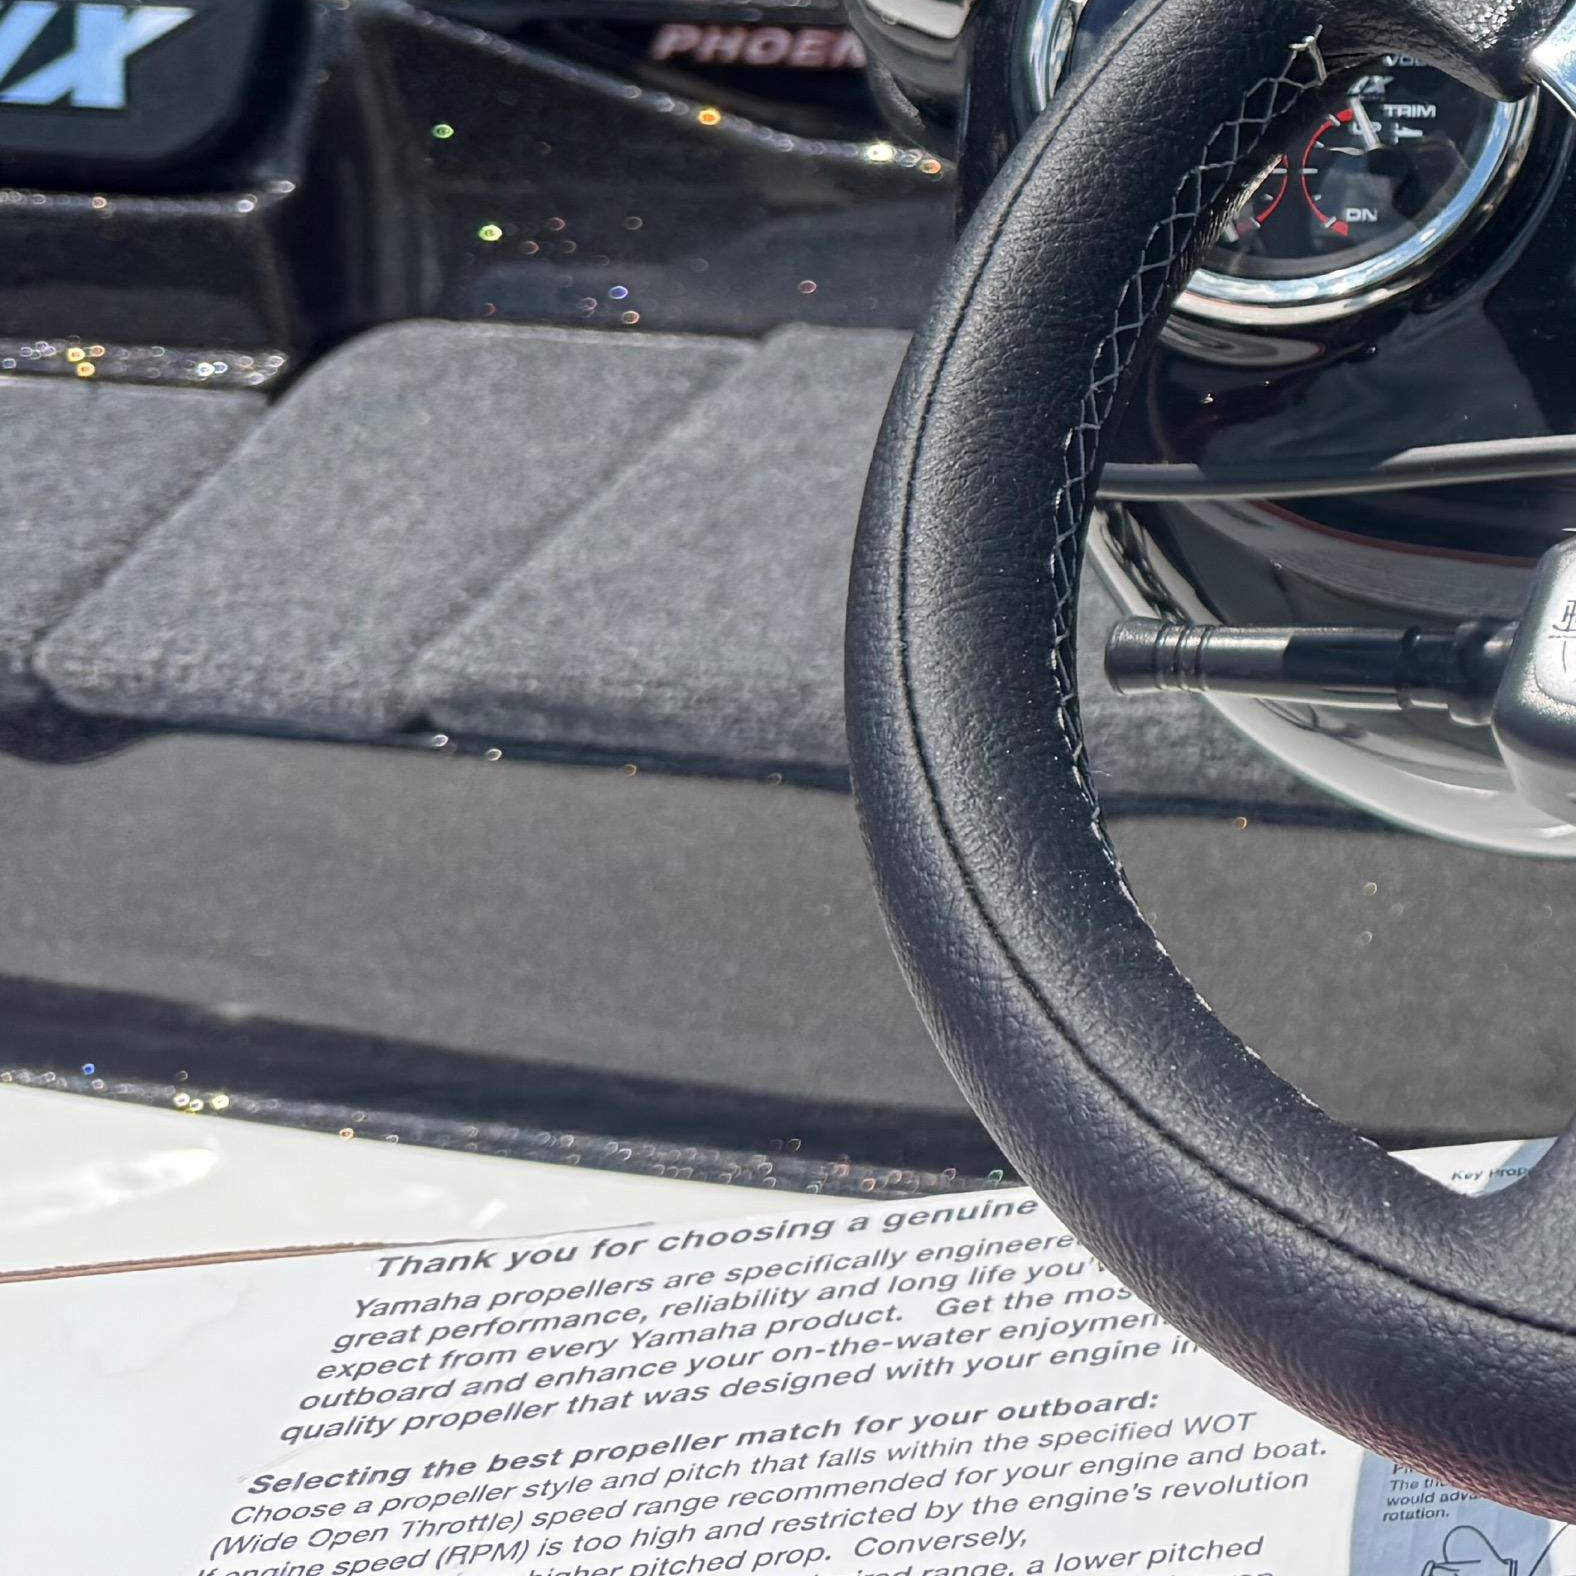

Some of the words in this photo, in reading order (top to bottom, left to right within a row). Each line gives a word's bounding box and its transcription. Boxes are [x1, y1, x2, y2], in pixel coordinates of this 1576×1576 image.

[1383, 104, 1436, 119] TRIM
[1345, 208, 1378, 222] DN
[377, 1249, 498, 1277] Thank
[503, 1242, 579, 1272] you
[590, 1238, 648, 1260] for
[658, 1220, 836, 1252] choosing
[847, 1217, 870, 1232] a
[882, 1198, 1038, 1233] genuine
[331, 1324, 422, 1353] great
[425, 1308, 647, 1346] performance,
[659, 1287, 810, 1318] reliability
[816, 1277, 880, 1301] and
[888, 1274, 958, 1294] long
[968, 1265, 1016, 1286] life
[356, 1292, 481, 1318] Yamaha
[486, 1278, 655, 1312] propellers
[663, 1271, 715, 1289] are
[724, 1248, 907, 1285] specifically
[299, 1378, 456, 1410] outboard
[461, 1372, 528, 1396] and
[535, 1361, 677, 1388] enhance
[683, 1350, 764, 1377] your
[772, 1327, 992, 1363] on-the-water
[999, 1313, 1166, 1341] enjoymen
[317, 1353, 432, 1381] expect
[439, 1349, 517, 1369] from
[526, 1338, 619, 1361] every
[632, 1321, 757, 1350] Yamaha
[764, 1305, 902, 1339] product.
[936, 1295, 994, 1316] Get
[1004, 1291, 1054, 1310] the
[280, 1415, 398, 1445] quality
[400, 1401, 559, 1436] propeller
[566, 1390, 634, 1414] that
[644, 1386, 710, 1406] was
[720, 1363, 876, 1398] designed
[887, 1356, 954, 1380] with
[962, 1352, 1042, 1378] your
[1050, 1340, 1161, 1366] engine
[231, 1503, 346, 1525] Choose
[353, 1500, 373, 1514] a
[378, 1484, 518, 1517] propeller
[522, 1475, 593, 1501] style
[600, 1466, 660, 1490] and
[663, 1459, 740, 1488] pitch
[751, 1453, 808, 1474] that
[817, 1447, 876, 1469] falls
[888, 1437, 973, 1461] within
[984, 1433, 1029, 1452] the
[1038, 1419, 1173, 1451] specified
[1185, 1413, 1257, 1436] WOT
[248, 1466, 412, 1494] Selecting
[422, 1459, 477, 1479] the
[486, 1449, 564, 1473] best
[569, 1434, 729, 1469] propeller
[735, 1419, 841, 1446] match
[854, 1415, 903, 1435] for
[908, 1409, 989, 1434] your
[997, 1390, 1159, 1421] outboard:
[210, 1532, 298, 1561] (Wide
[308, 1527, 389, 1551] Open
[402, 1510, 523, 1539] Throttle)
[531, 1499, 628, 1530] speed
[632, 1496, 719, 1517] range
[727, 1468, 947, 1508] recommended
[955, 1466, 998, 1486] for
[1002, 1462, 1072, 1487] your
[1080, 1452, 1178, 1476] engine
[1188, 1443, 1244, 1465] and
[1253, 1437, 1328, 1460] boat.
[332, 1549, 431, 1576] speed
[436, 1539, 529, 1570] (RPM)
[537, 1537, 563, 1557] is
[573, 1535, 622, 1553] too
[630, 1524, 696, 1549] high
[704, 1516, 765, 1540] and
[771, 1502, 917, 1534] restricted
[925, 1500, 964, 1523] by
[972, 1495, 1018, 1515] the
[1028, 1483, 1152, 1512] engine's
[1162, 1471, 1308, 1499] revolution
[1383, 1508, 1450, 1522] rotation.
[1387, 1492, 1435, 1506] would
[1390, 1479, 1419, 1491] The
[629, 1549, 747, 1576] pitched
[751, 1547, 831, 1573] prop.
[854, 1525, 1026, 1557] Conversely,
[1026, 1560, 1044, 1575] a
[1054, 1551, 1142, 1573] lower
[1146, 1536, 1264, 1570] pitched
